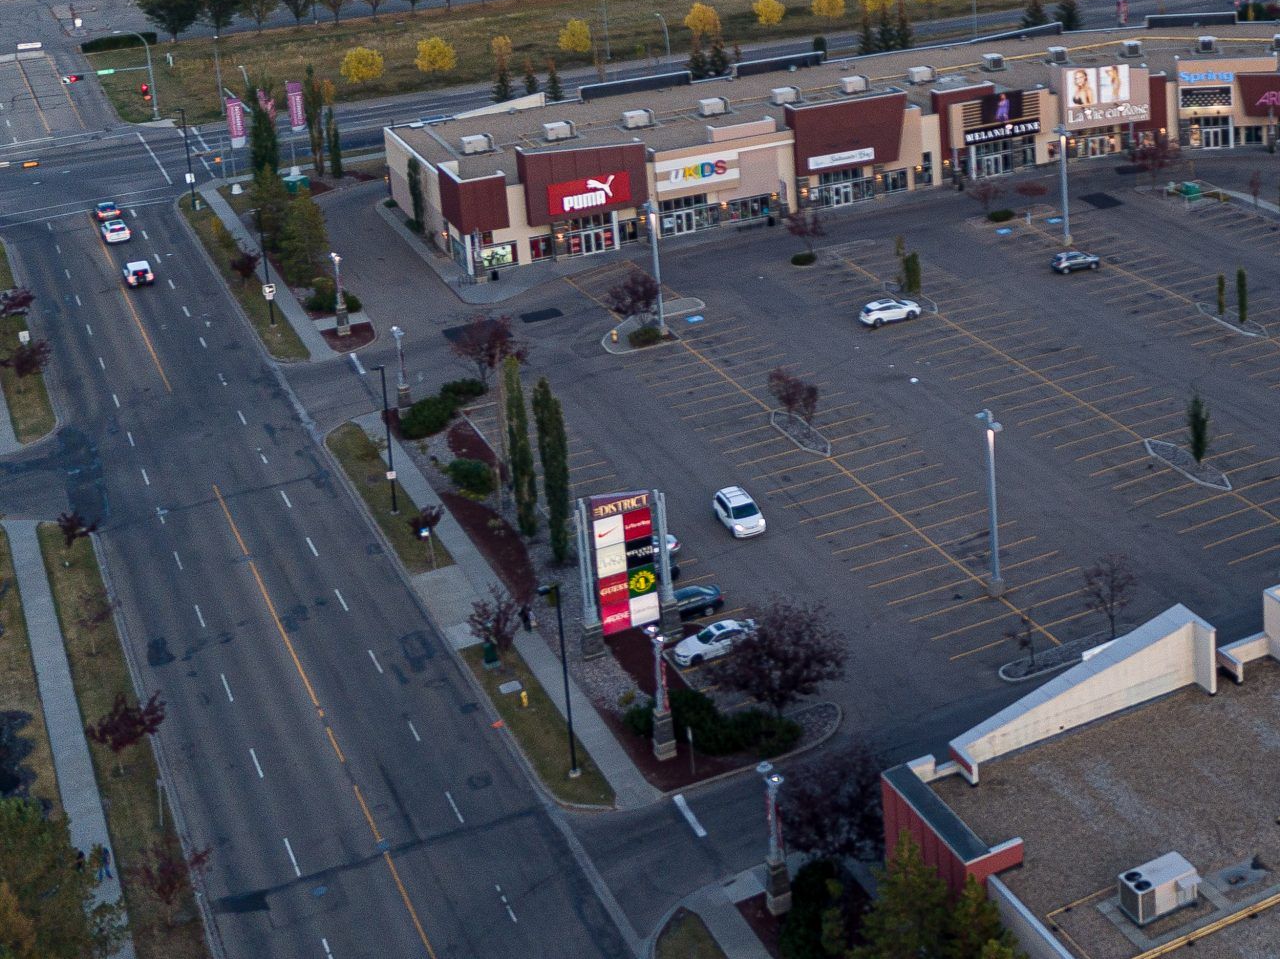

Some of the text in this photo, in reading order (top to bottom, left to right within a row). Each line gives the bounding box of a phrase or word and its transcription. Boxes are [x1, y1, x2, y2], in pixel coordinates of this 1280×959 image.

[1178, 70, 1235, 84] Spring
[1068, 109, 1084, 124] La
[562, 190, 607, 212] PUMA
[600, 494, 649, 516] DISTRICT
